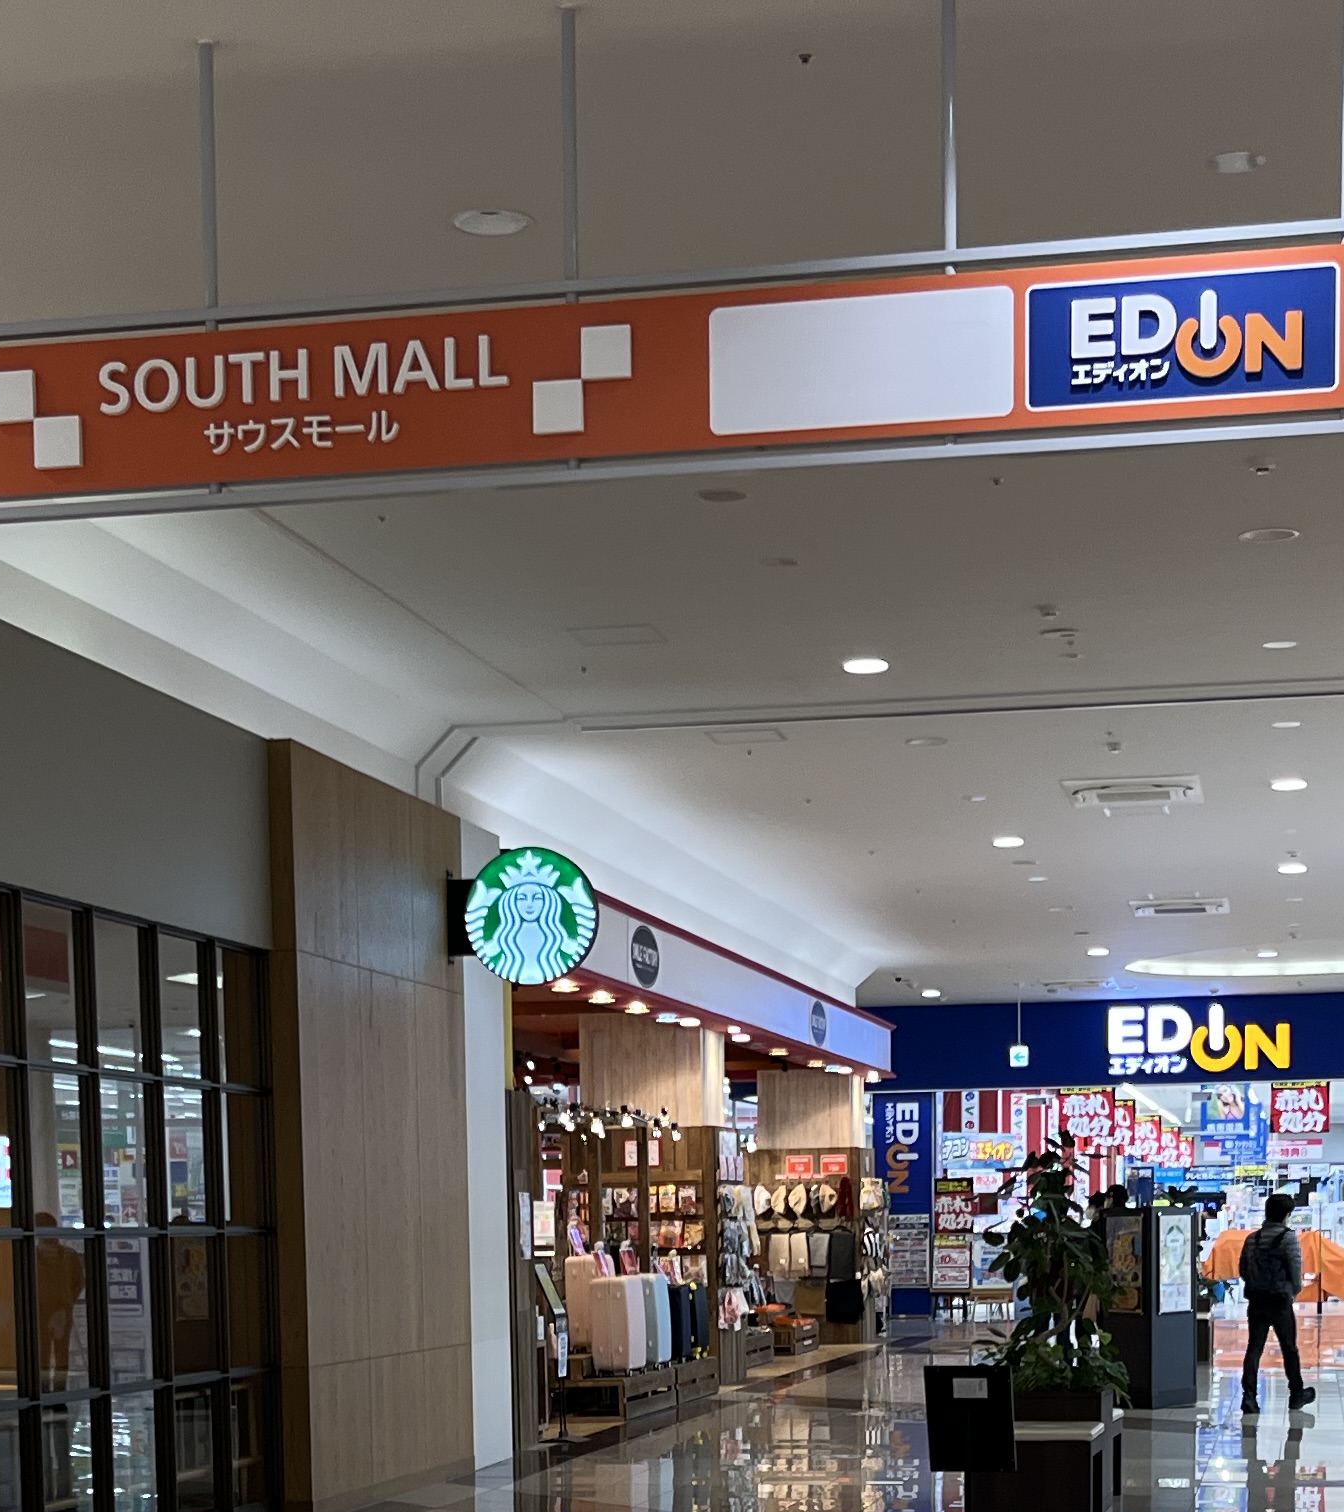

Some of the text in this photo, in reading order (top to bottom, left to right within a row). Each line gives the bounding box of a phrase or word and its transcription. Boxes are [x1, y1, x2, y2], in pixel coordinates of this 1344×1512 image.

[1070, 289, 1303, 379] EDION
[98, 334, 510, 416] SOUTH MALL
[1070, 358, 1171, 386] エディオン
[204, 410, 400, 455] サウスモール
[1108, 1003, 1291, 1073] EDION
[1108, 1054, 1188, 1075] エディオン
[1275, 1088, 1324, 1112] 赤札
[886, 1102, 919, 1194] EDION
